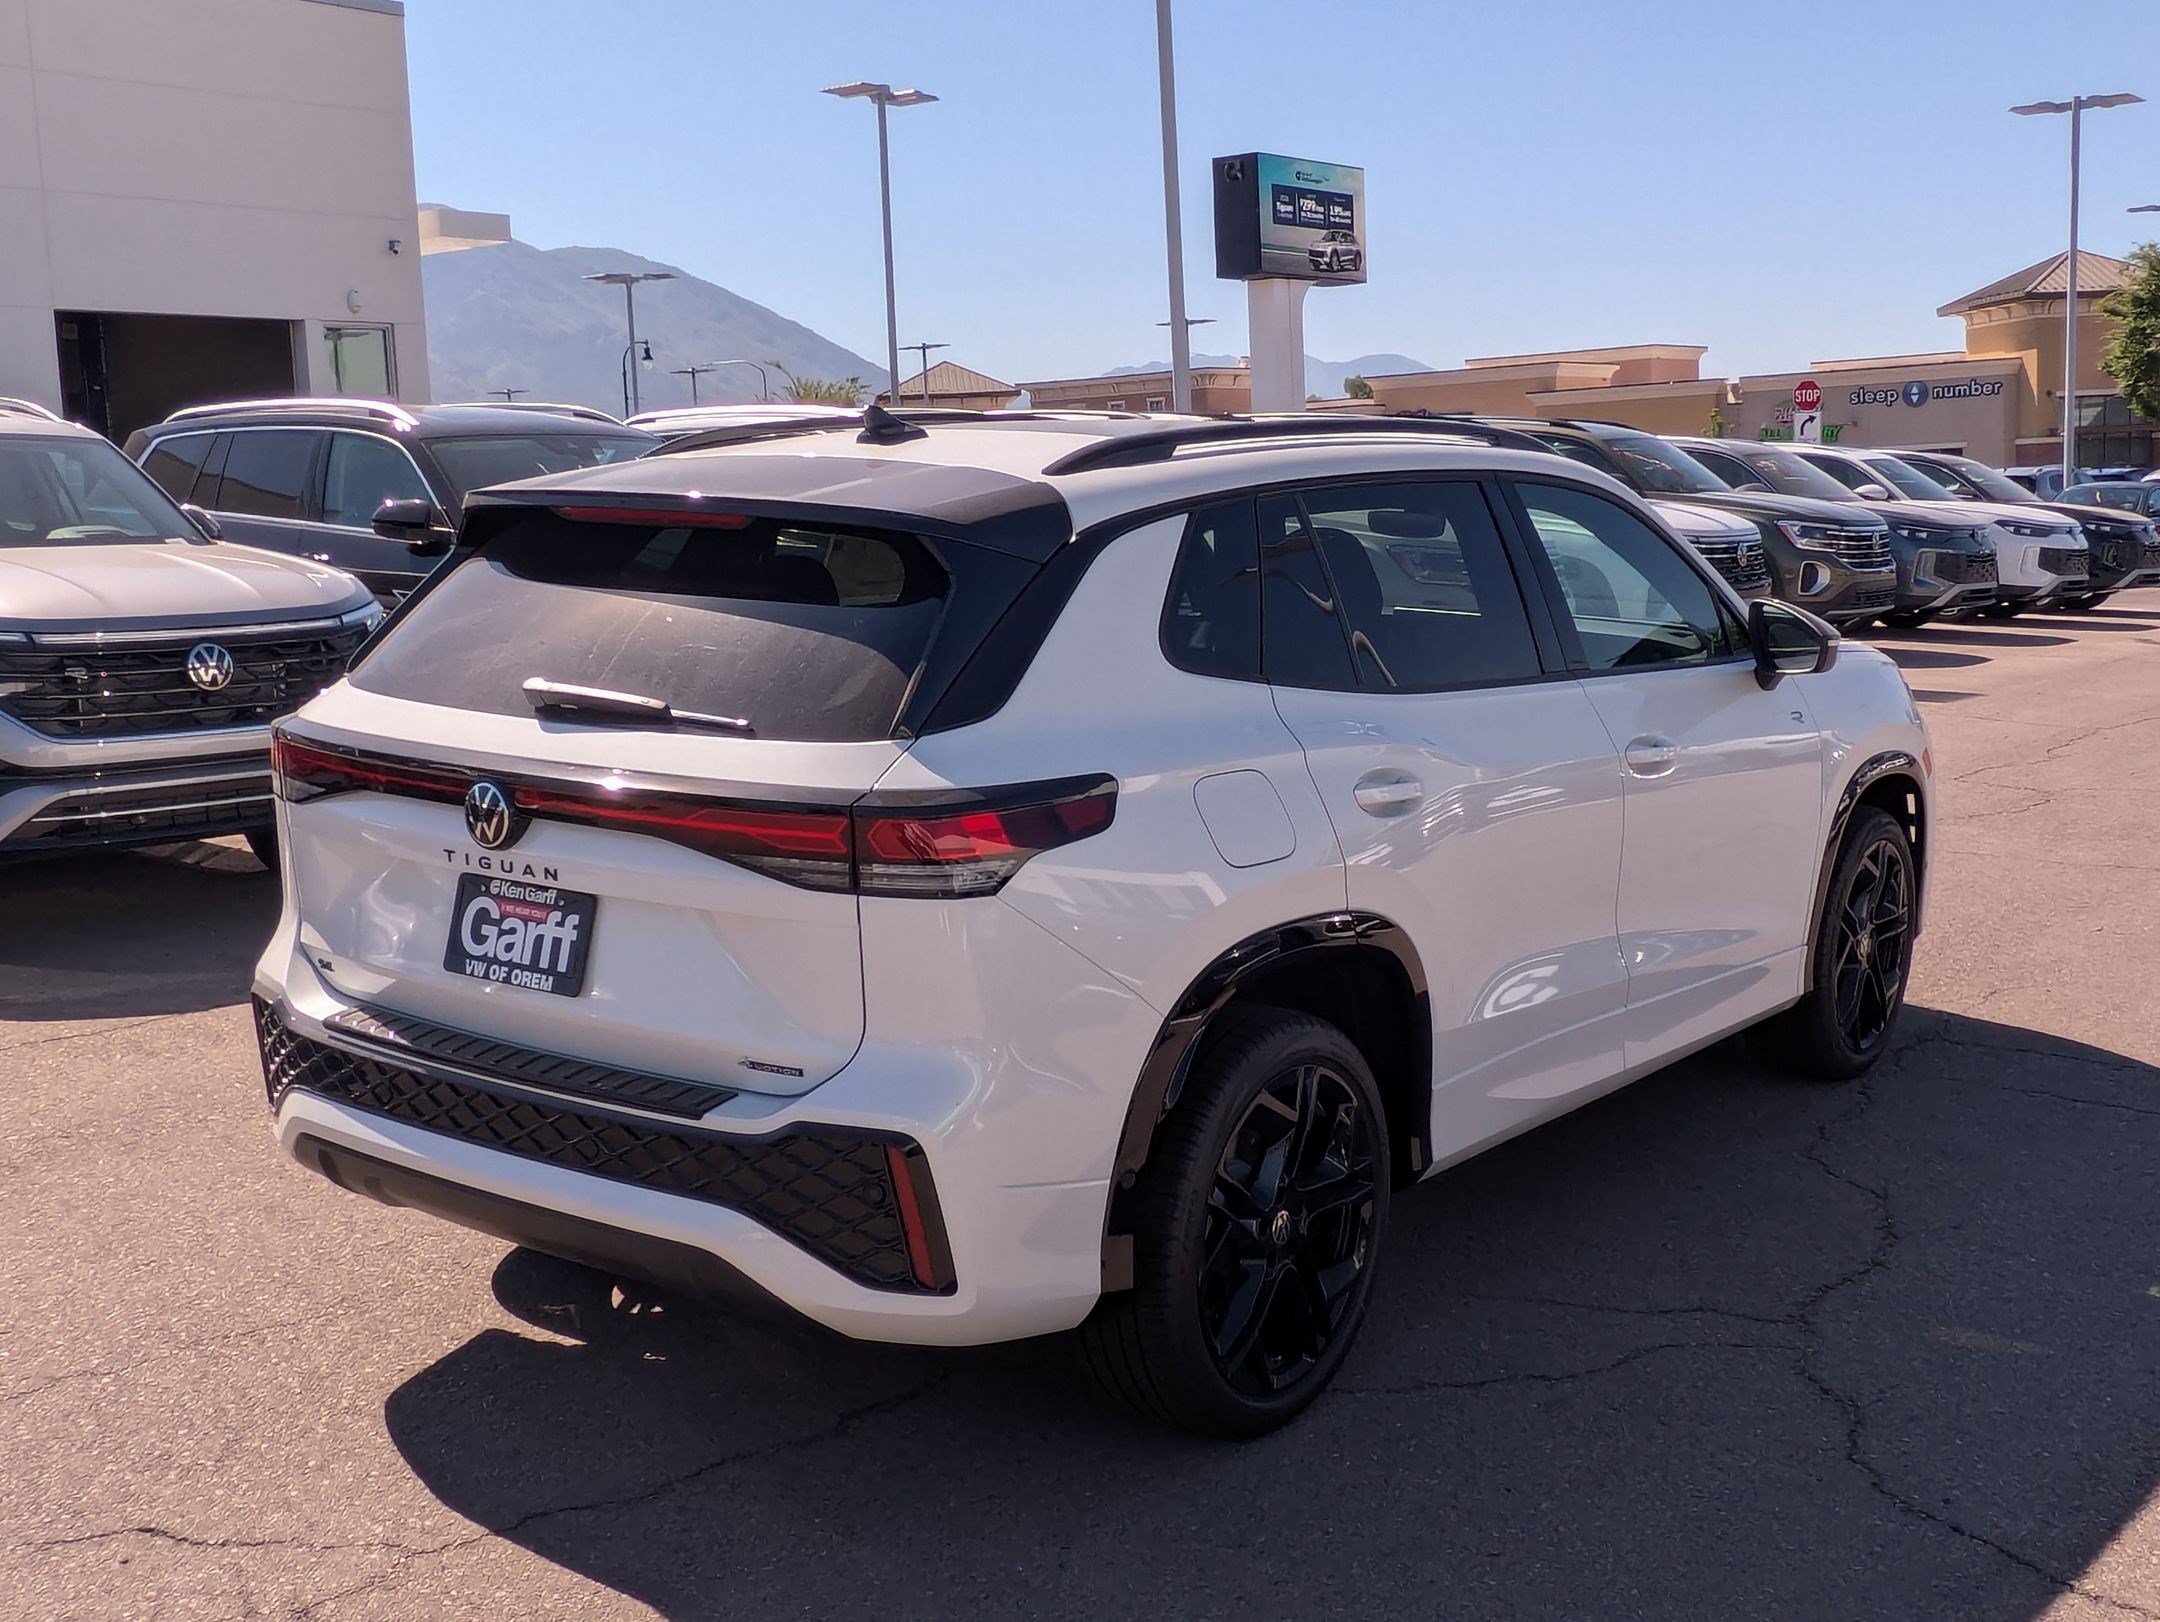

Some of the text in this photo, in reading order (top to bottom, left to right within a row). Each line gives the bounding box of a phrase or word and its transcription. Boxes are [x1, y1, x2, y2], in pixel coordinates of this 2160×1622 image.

[1795, 389, 1820, 402] STOP
[1850, 379, 2003, 406] sleep number
[443, 849, 560, 882] TIGUAN
[500, 880, 557, 904] Ken Garff
[461, 896, 580, 973] Garff
[465, 959, 554, 991] VW OF OREM
